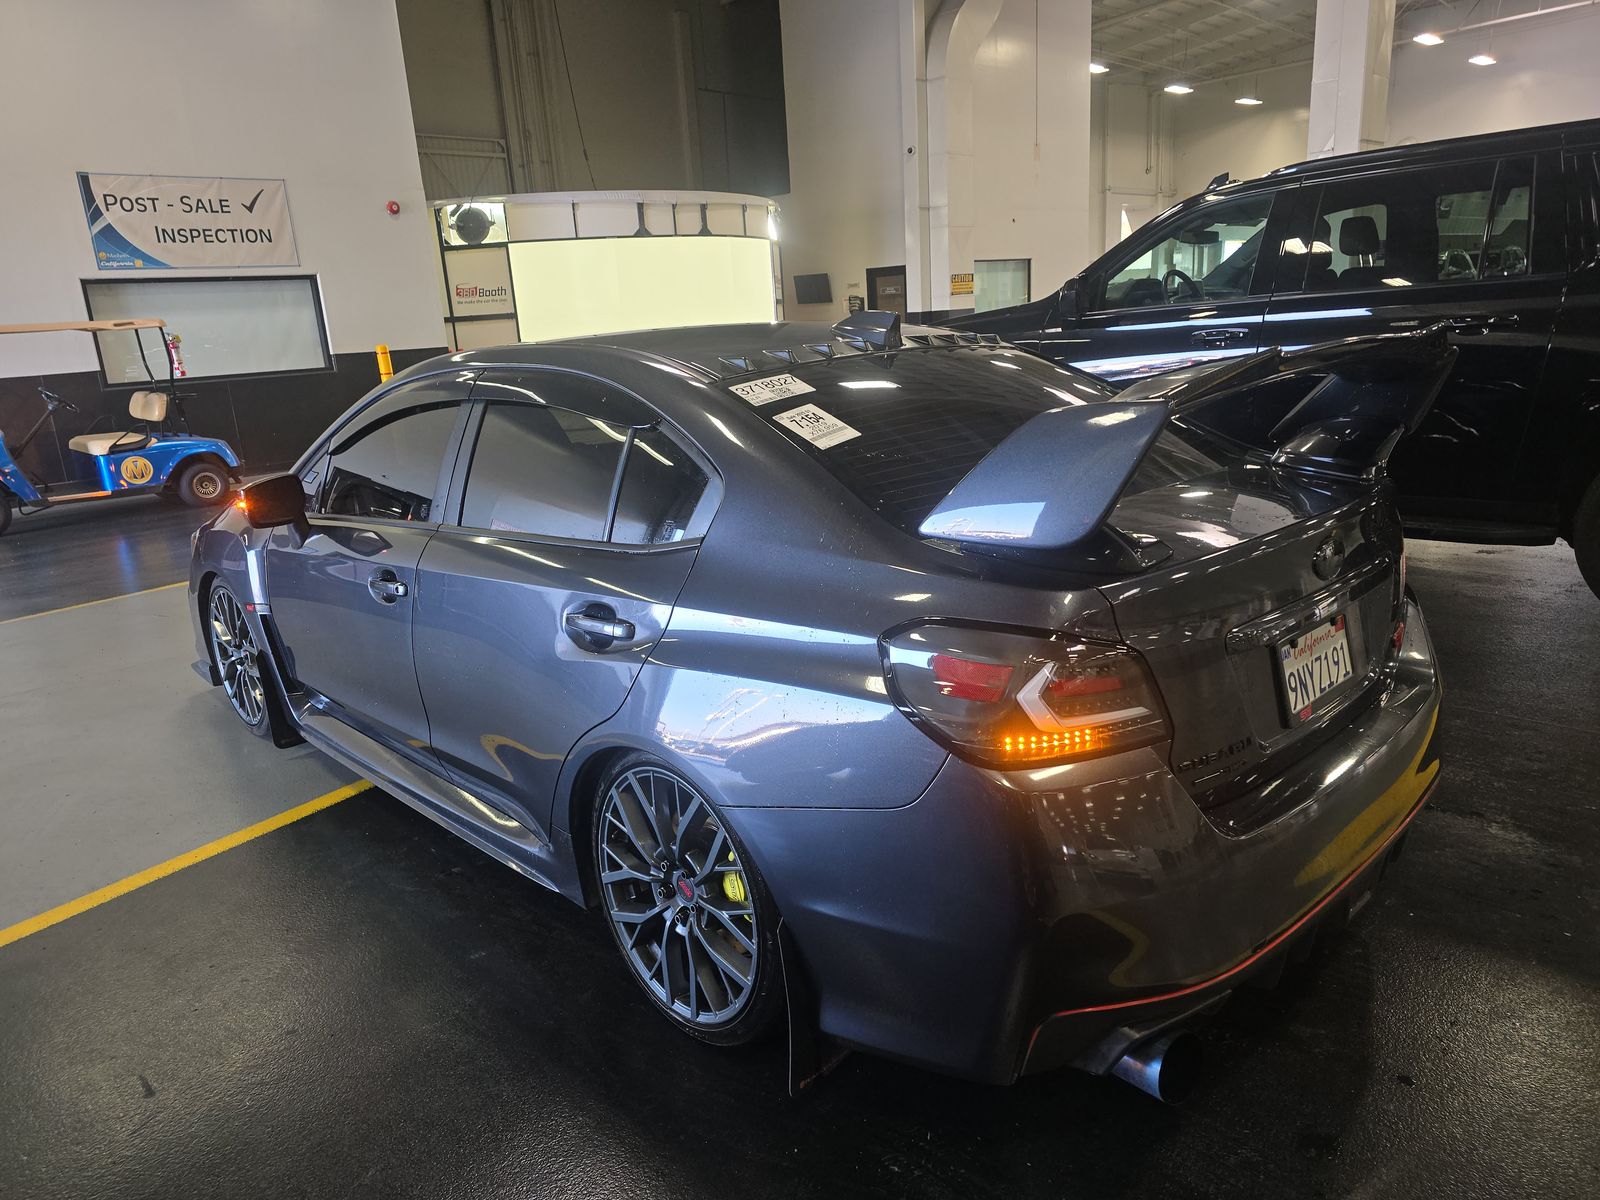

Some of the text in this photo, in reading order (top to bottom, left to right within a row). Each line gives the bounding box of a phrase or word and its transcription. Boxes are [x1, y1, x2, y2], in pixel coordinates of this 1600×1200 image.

[102, 193, 160, 213] POST
[179, 195, 232, 214] SALE
[154, 225, 274, 244] INSPECTION
[735, 376, 797, 396] 3718027
[1293, 629, 1336, 660] California
[1287, 641, 1351, 711] 9NYZ191
